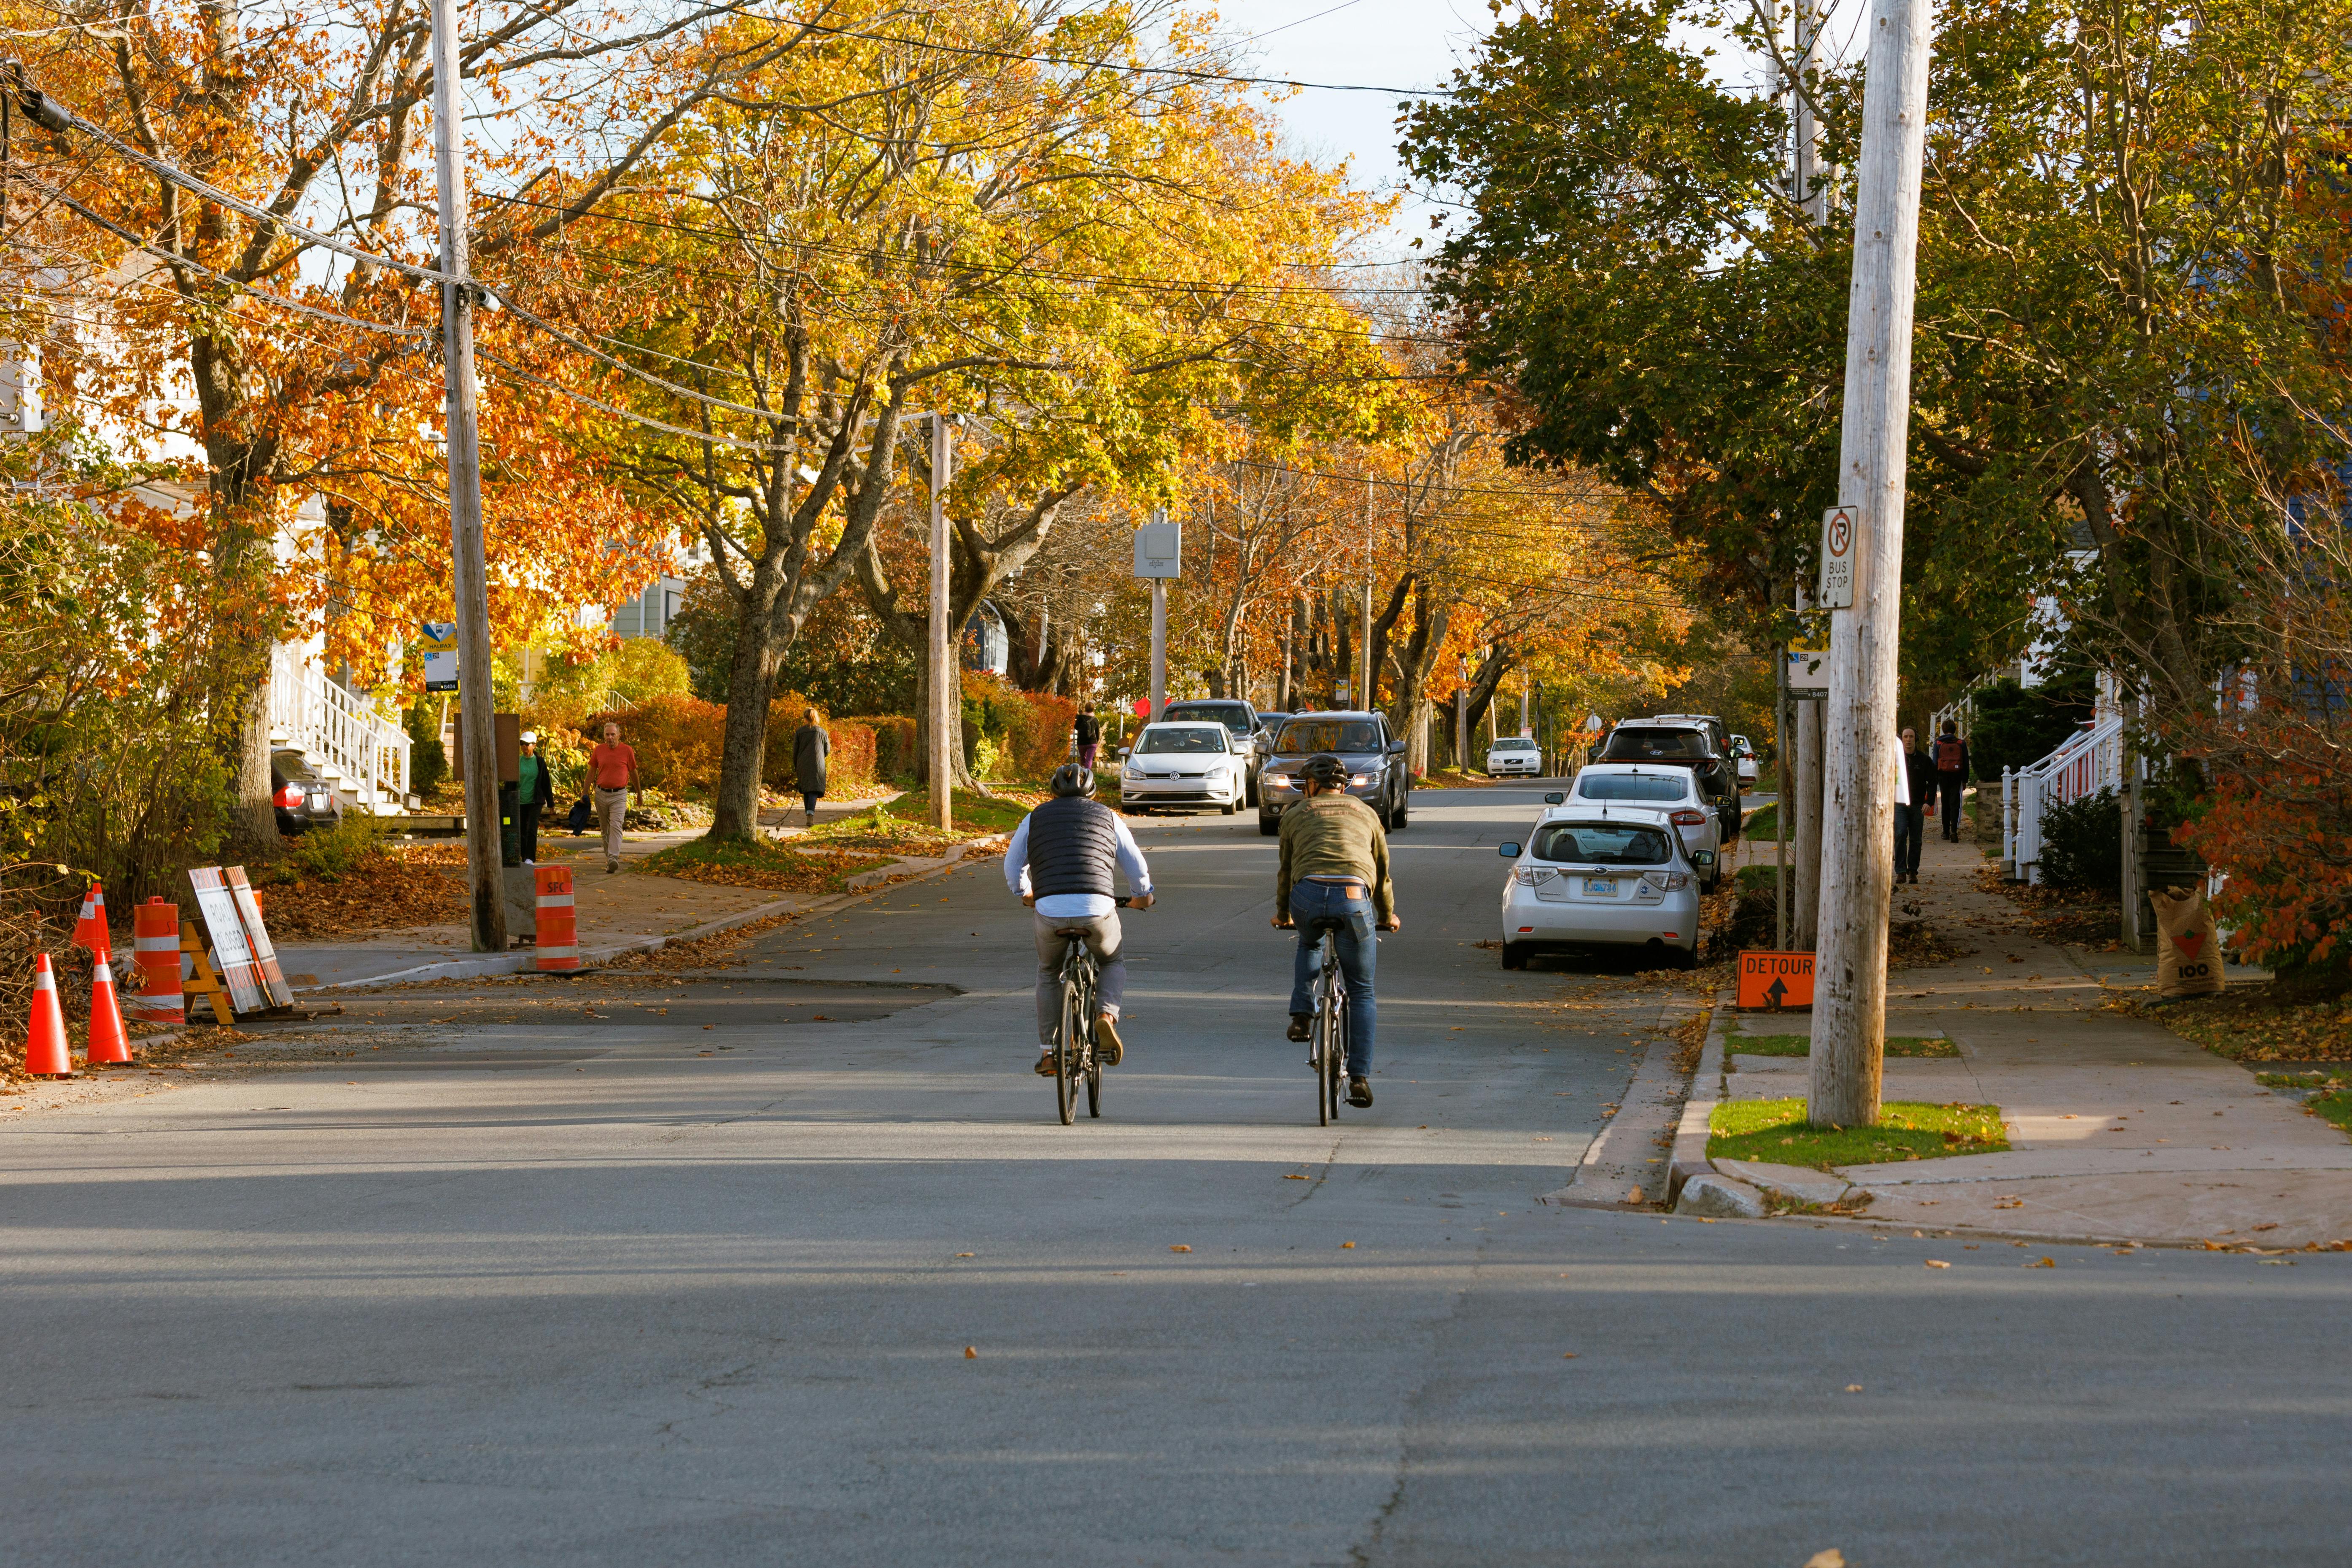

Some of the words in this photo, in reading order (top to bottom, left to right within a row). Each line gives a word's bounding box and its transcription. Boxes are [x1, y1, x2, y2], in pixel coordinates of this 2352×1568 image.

[1149, 560, 1164, 568] alpha
[1829, 561, 1847, 574] BUS
[1827, 576, 1848, 588] STOP
[1170, 771, 1180, 780] VW
[547, 882, 565, 893] SFC
[210, 903, 231, 923] ROAD
[217, 930, 244, 952] CLOSED
[1746, 958, 1813, 975] DETOUR
[2178, 963, 2209, 978] 100
